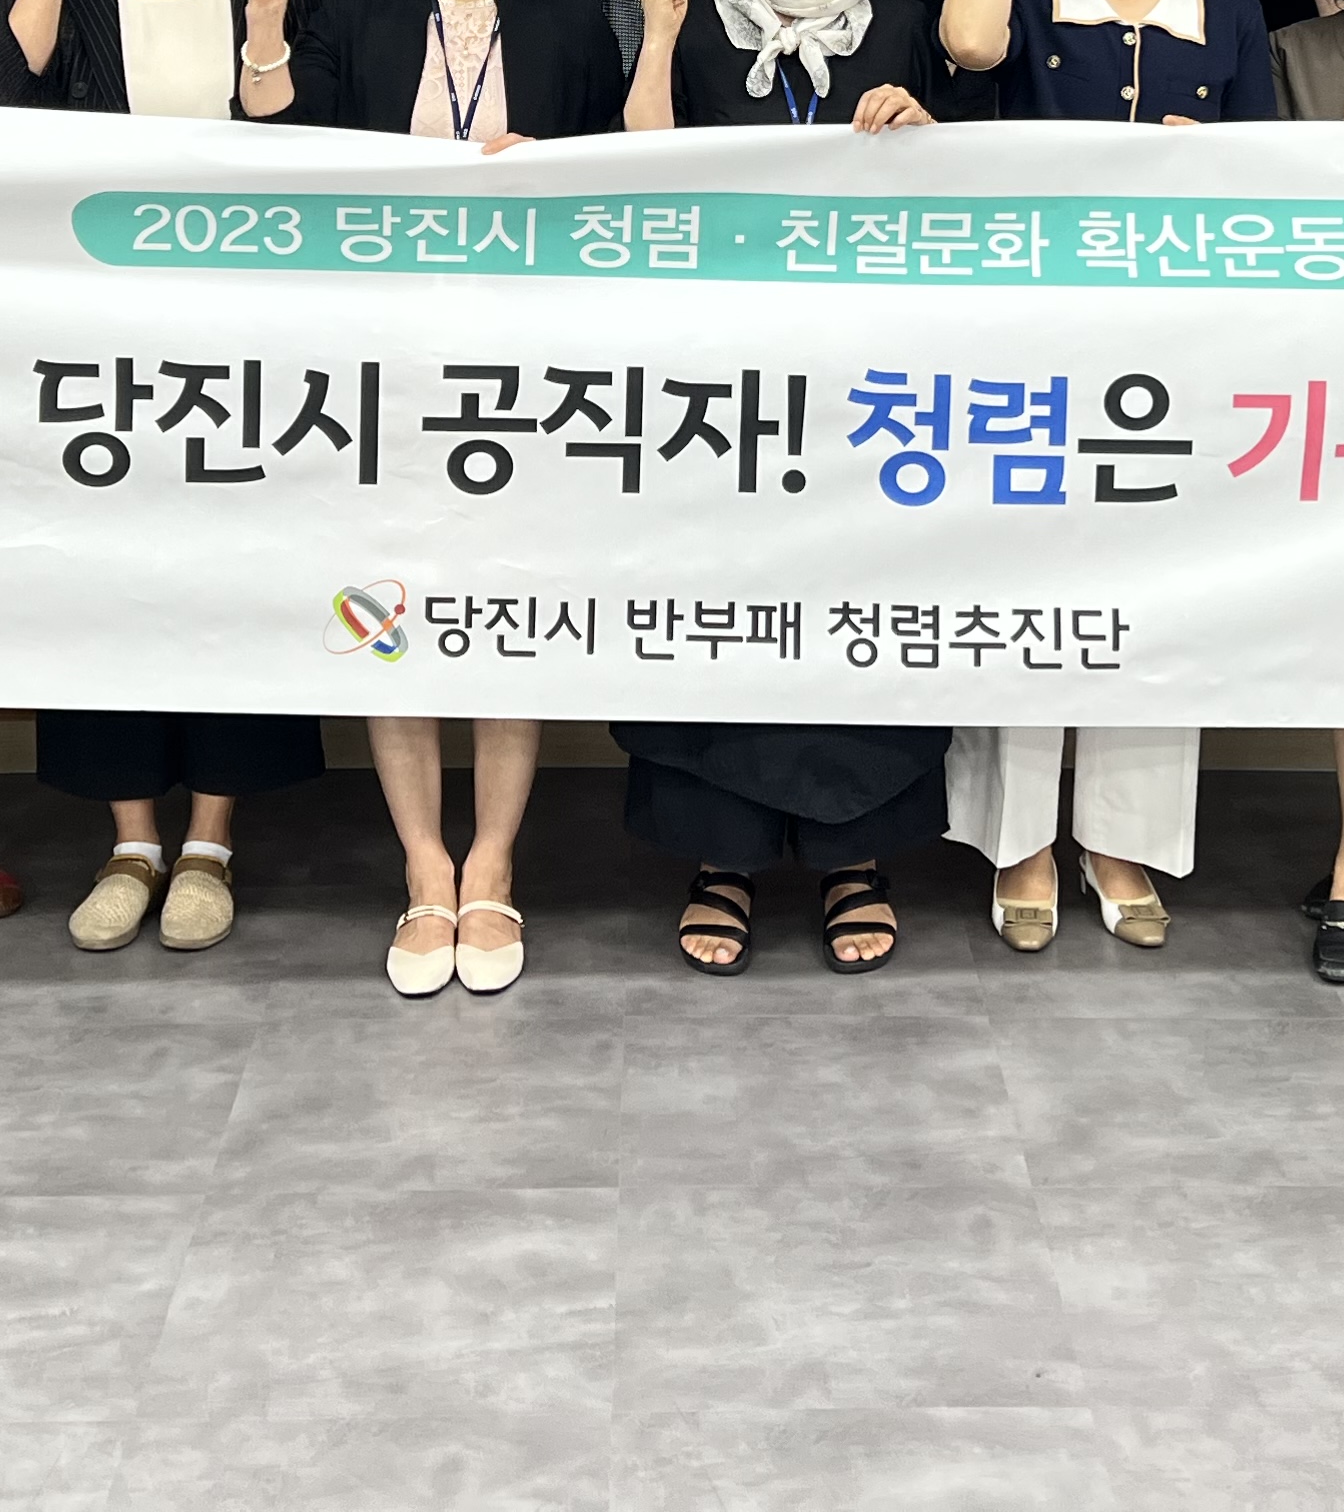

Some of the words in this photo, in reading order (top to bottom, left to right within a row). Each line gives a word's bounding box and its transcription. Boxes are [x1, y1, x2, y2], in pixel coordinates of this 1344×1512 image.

[132, 204, 303, 256] 2023
[336, 205, 537, 266] 당진시
[571, 206, 699, 268] 청렴
[777, 211, 1049, 277] 친절문화
[33, 358, 379, 487] 당진시
[423, 365, 806, 494] 공직자!
[849, 370, 1192, 506] 청렴은
[426, 596, 595, 657] 당진시
[628, 599, 801, 660] 반부패
[829, 602, 1129, 669] 청렴추진단
